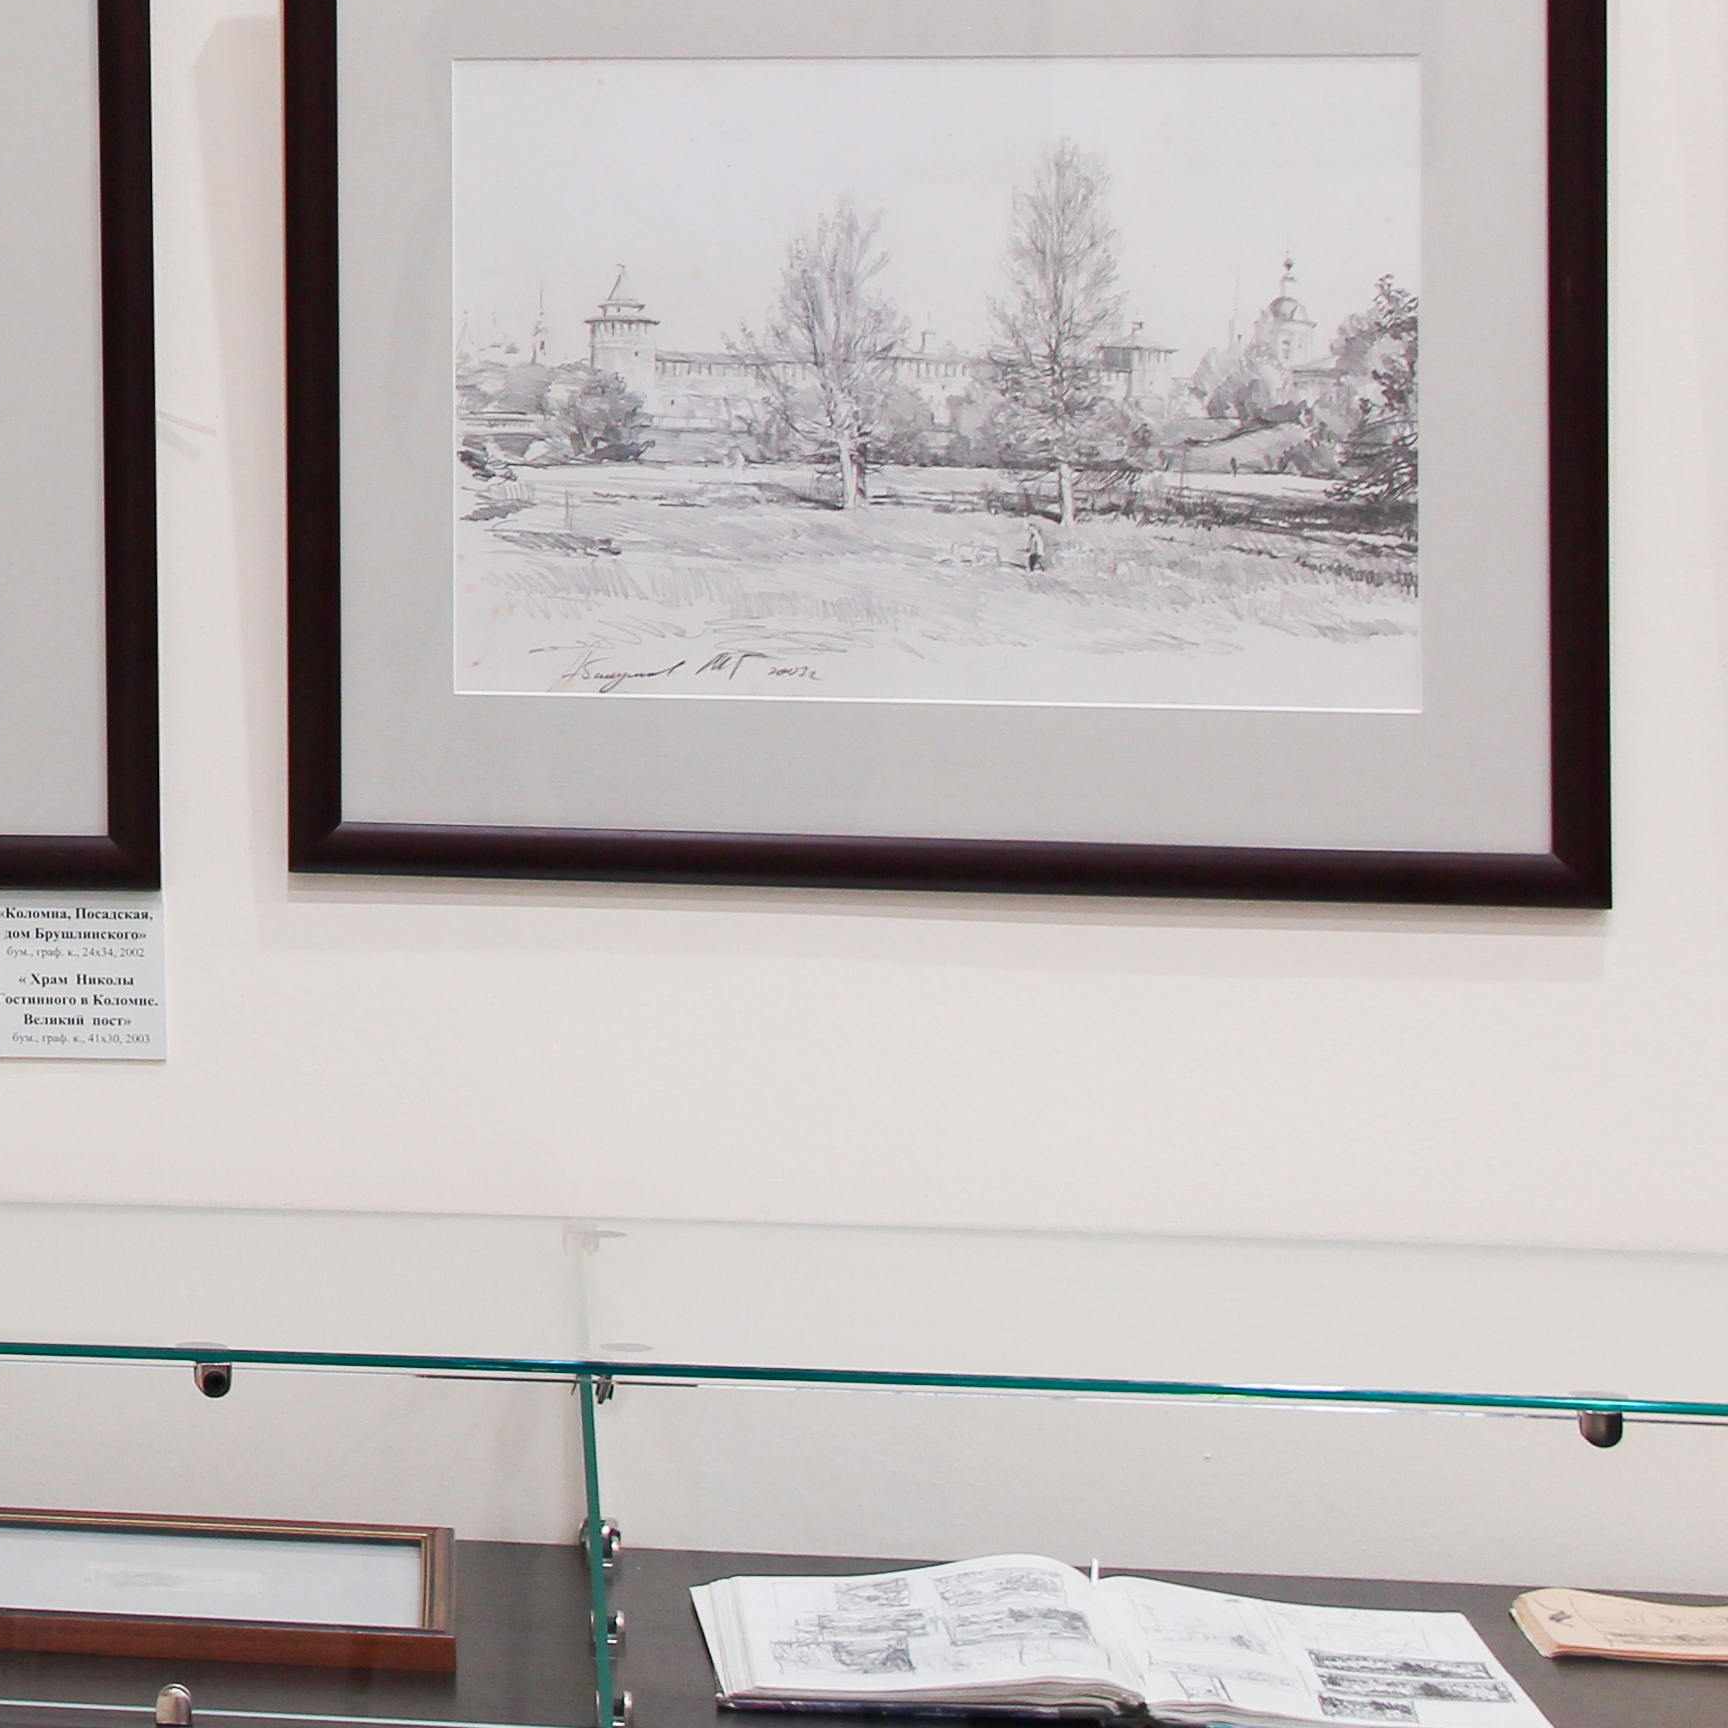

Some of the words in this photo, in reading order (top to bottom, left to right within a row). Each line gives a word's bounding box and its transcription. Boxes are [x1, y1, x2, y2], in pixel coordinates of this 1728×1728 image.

[75, 907, 153, 921] Посадская,
[4, 929, 31, 940] дом
[35, 927, 146, 942] Брушлинского»
[6, 946, 33, 958] бум.,
[37, 946, 64, 959] граф.
[120, 947, 145, 957] 2002
[76, 973, 134, 986] Николы
[81, 996, 89, 1005] в
[93, 993, 158, 1007] Коломне.
[24, 1013, 84, 1027] Великий
[93, 1017, 132, 1027] пост»
[12, 1032, 39, 1045] бум.,
[42, 1032, 69, 1045] граф.
[126, 1033, 150, 1044] 2003
